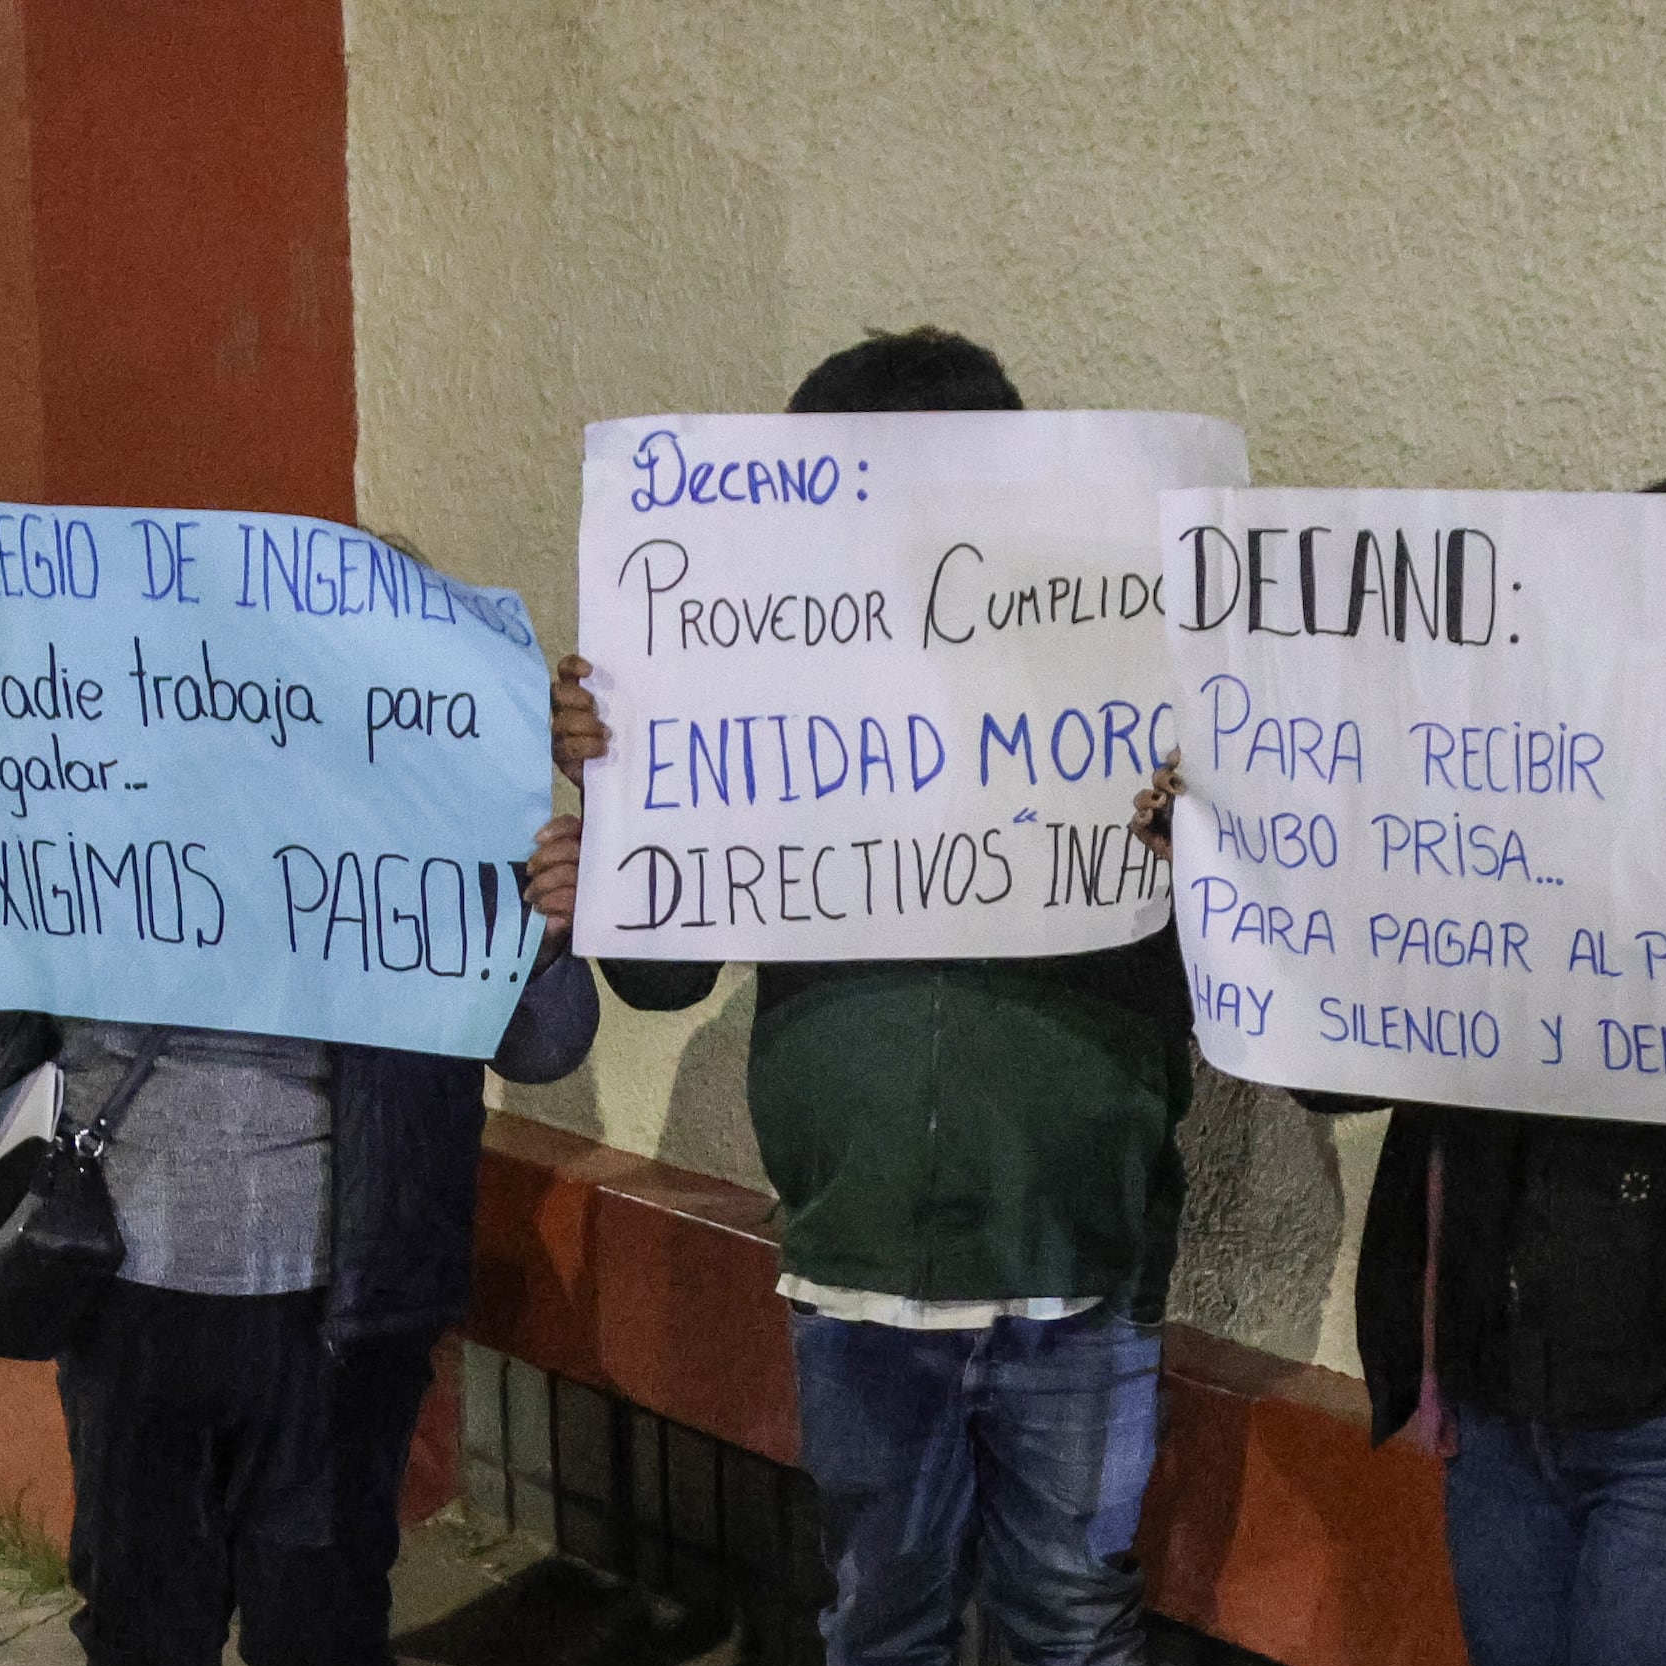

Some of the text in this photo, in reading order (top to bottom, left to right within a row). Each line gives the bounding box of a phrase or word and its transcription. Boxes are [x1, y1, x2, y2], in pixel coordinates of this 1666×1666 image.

[131, 517, 201, 602] DE
[618, 539, 893, 656] PROVEDOR
[1179, 524, 1522, 646] DECANO:
[129, 637, 322, 748] trabaja
[366, 686, 480, 763] para
[1200, 674, 1363, 784] PARA
[1409, 722, 1606, 801] RECIBIR
[644, 712, 946, 810] ENTIDAD
[616, 828, 1013, 931] DIRECTIVOS
[1212, 801, 1566, 886] HUBO PRISA...
[273, 844, 534, 983] PAGO!!
[1190, 876, 1335, 956] PARA
[1368, 912, 1533, 973] PAGAR
[1569, 928, 1622, 977] AL
[1194, 963, 1274, 1036] HAY
[1319, 996, 1499, 1059] SILENCIO
